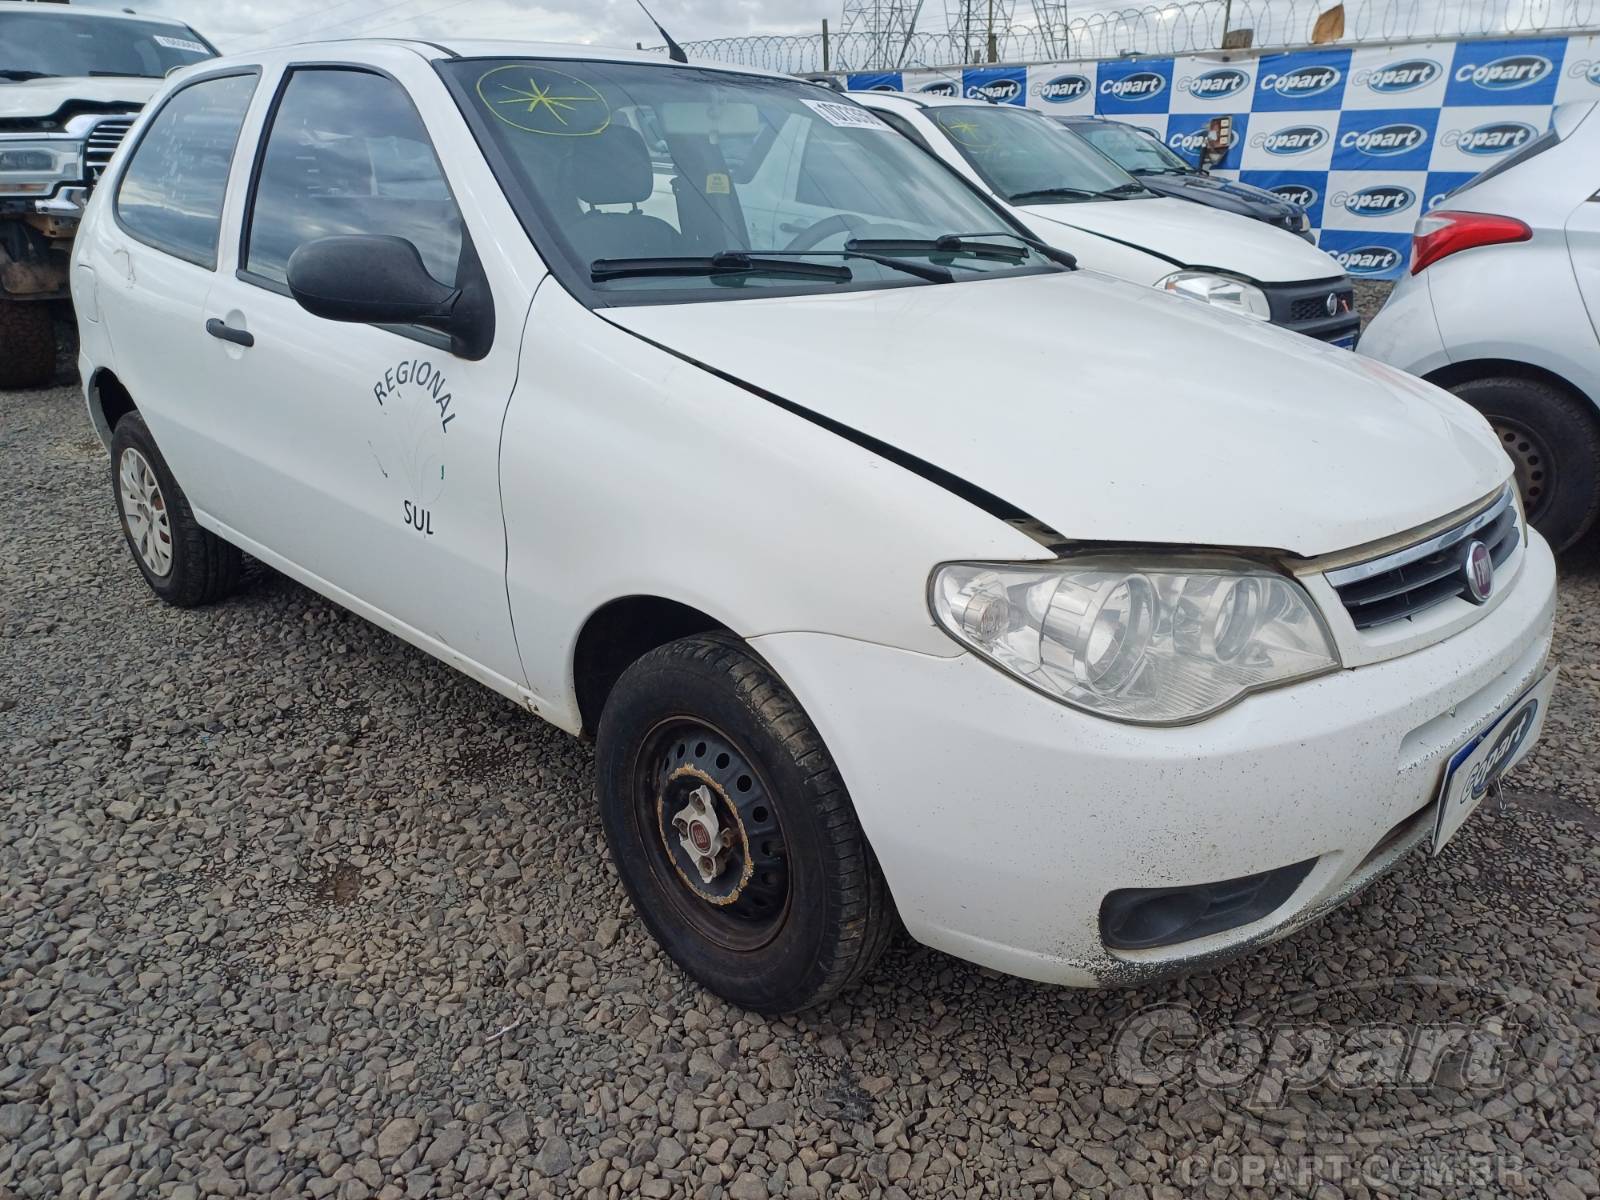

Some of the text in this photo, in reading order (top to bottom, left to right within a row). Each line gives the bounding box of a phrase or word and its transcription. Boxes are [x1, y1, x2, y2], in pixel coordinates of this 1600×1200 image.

[1260, 67, 1334, 92] Copart
[1352, 65, 1432, 88] Copart
[1455, 60, 1541, 85] Copart
[1030, 80, 1083, 98] Copart
[1100, 74, 1161, 95] Copart
[1176, 73, 1241, 95] Copart
[1168, 133, 1208, 151] Cop
[1250, 130, 1321, 152] Copart
[1340, 130, 1418, 151] Copart
[1440, 126, 1527, 150] Copart
[1330, 190, 1406, 210] Copart
[373, 359, 456, 434] REGIONAL
[403, 499, 434, 535] SUL
